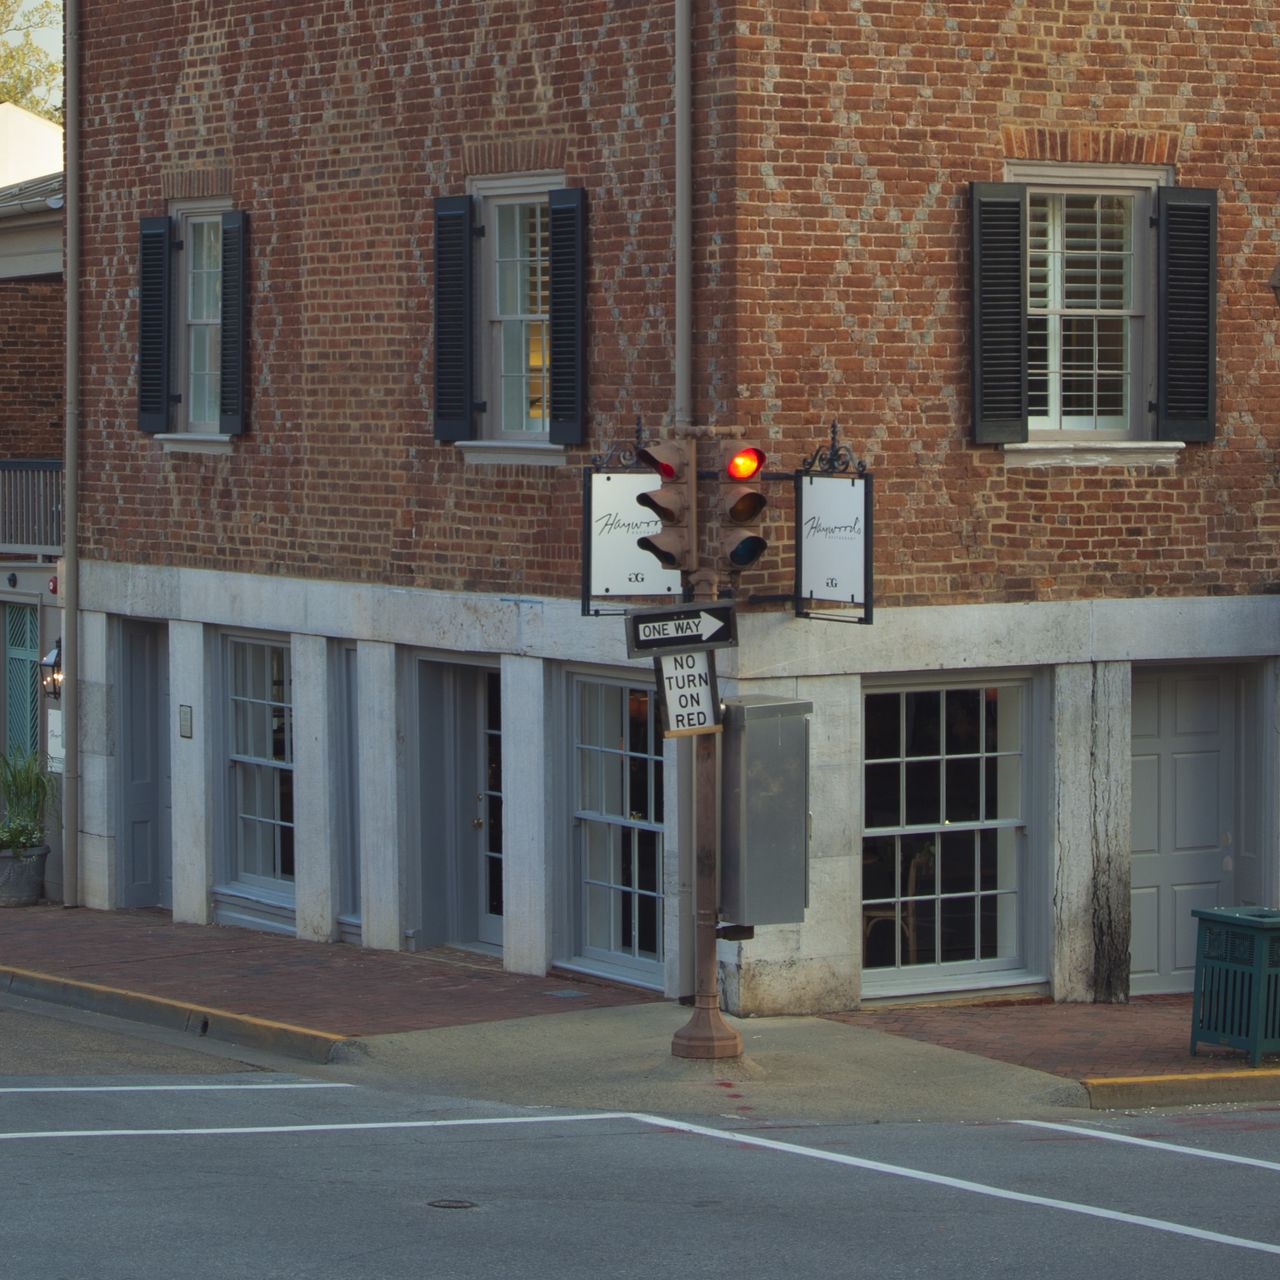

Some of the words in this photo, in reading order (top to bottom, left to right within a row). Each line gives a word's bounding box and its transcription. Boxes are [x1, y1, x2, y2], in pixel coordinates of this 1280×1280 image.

[804, 516, 862, 539] Haywoods
[643, 623, 670, 638] ONE
[674, 619, 702, 635] WAY
[673, 654, 696, 671] NO
[665, 672, 709, 691] TURN
[678, 692, 700, 708] ON
[675, 711, 707, 729] RED
